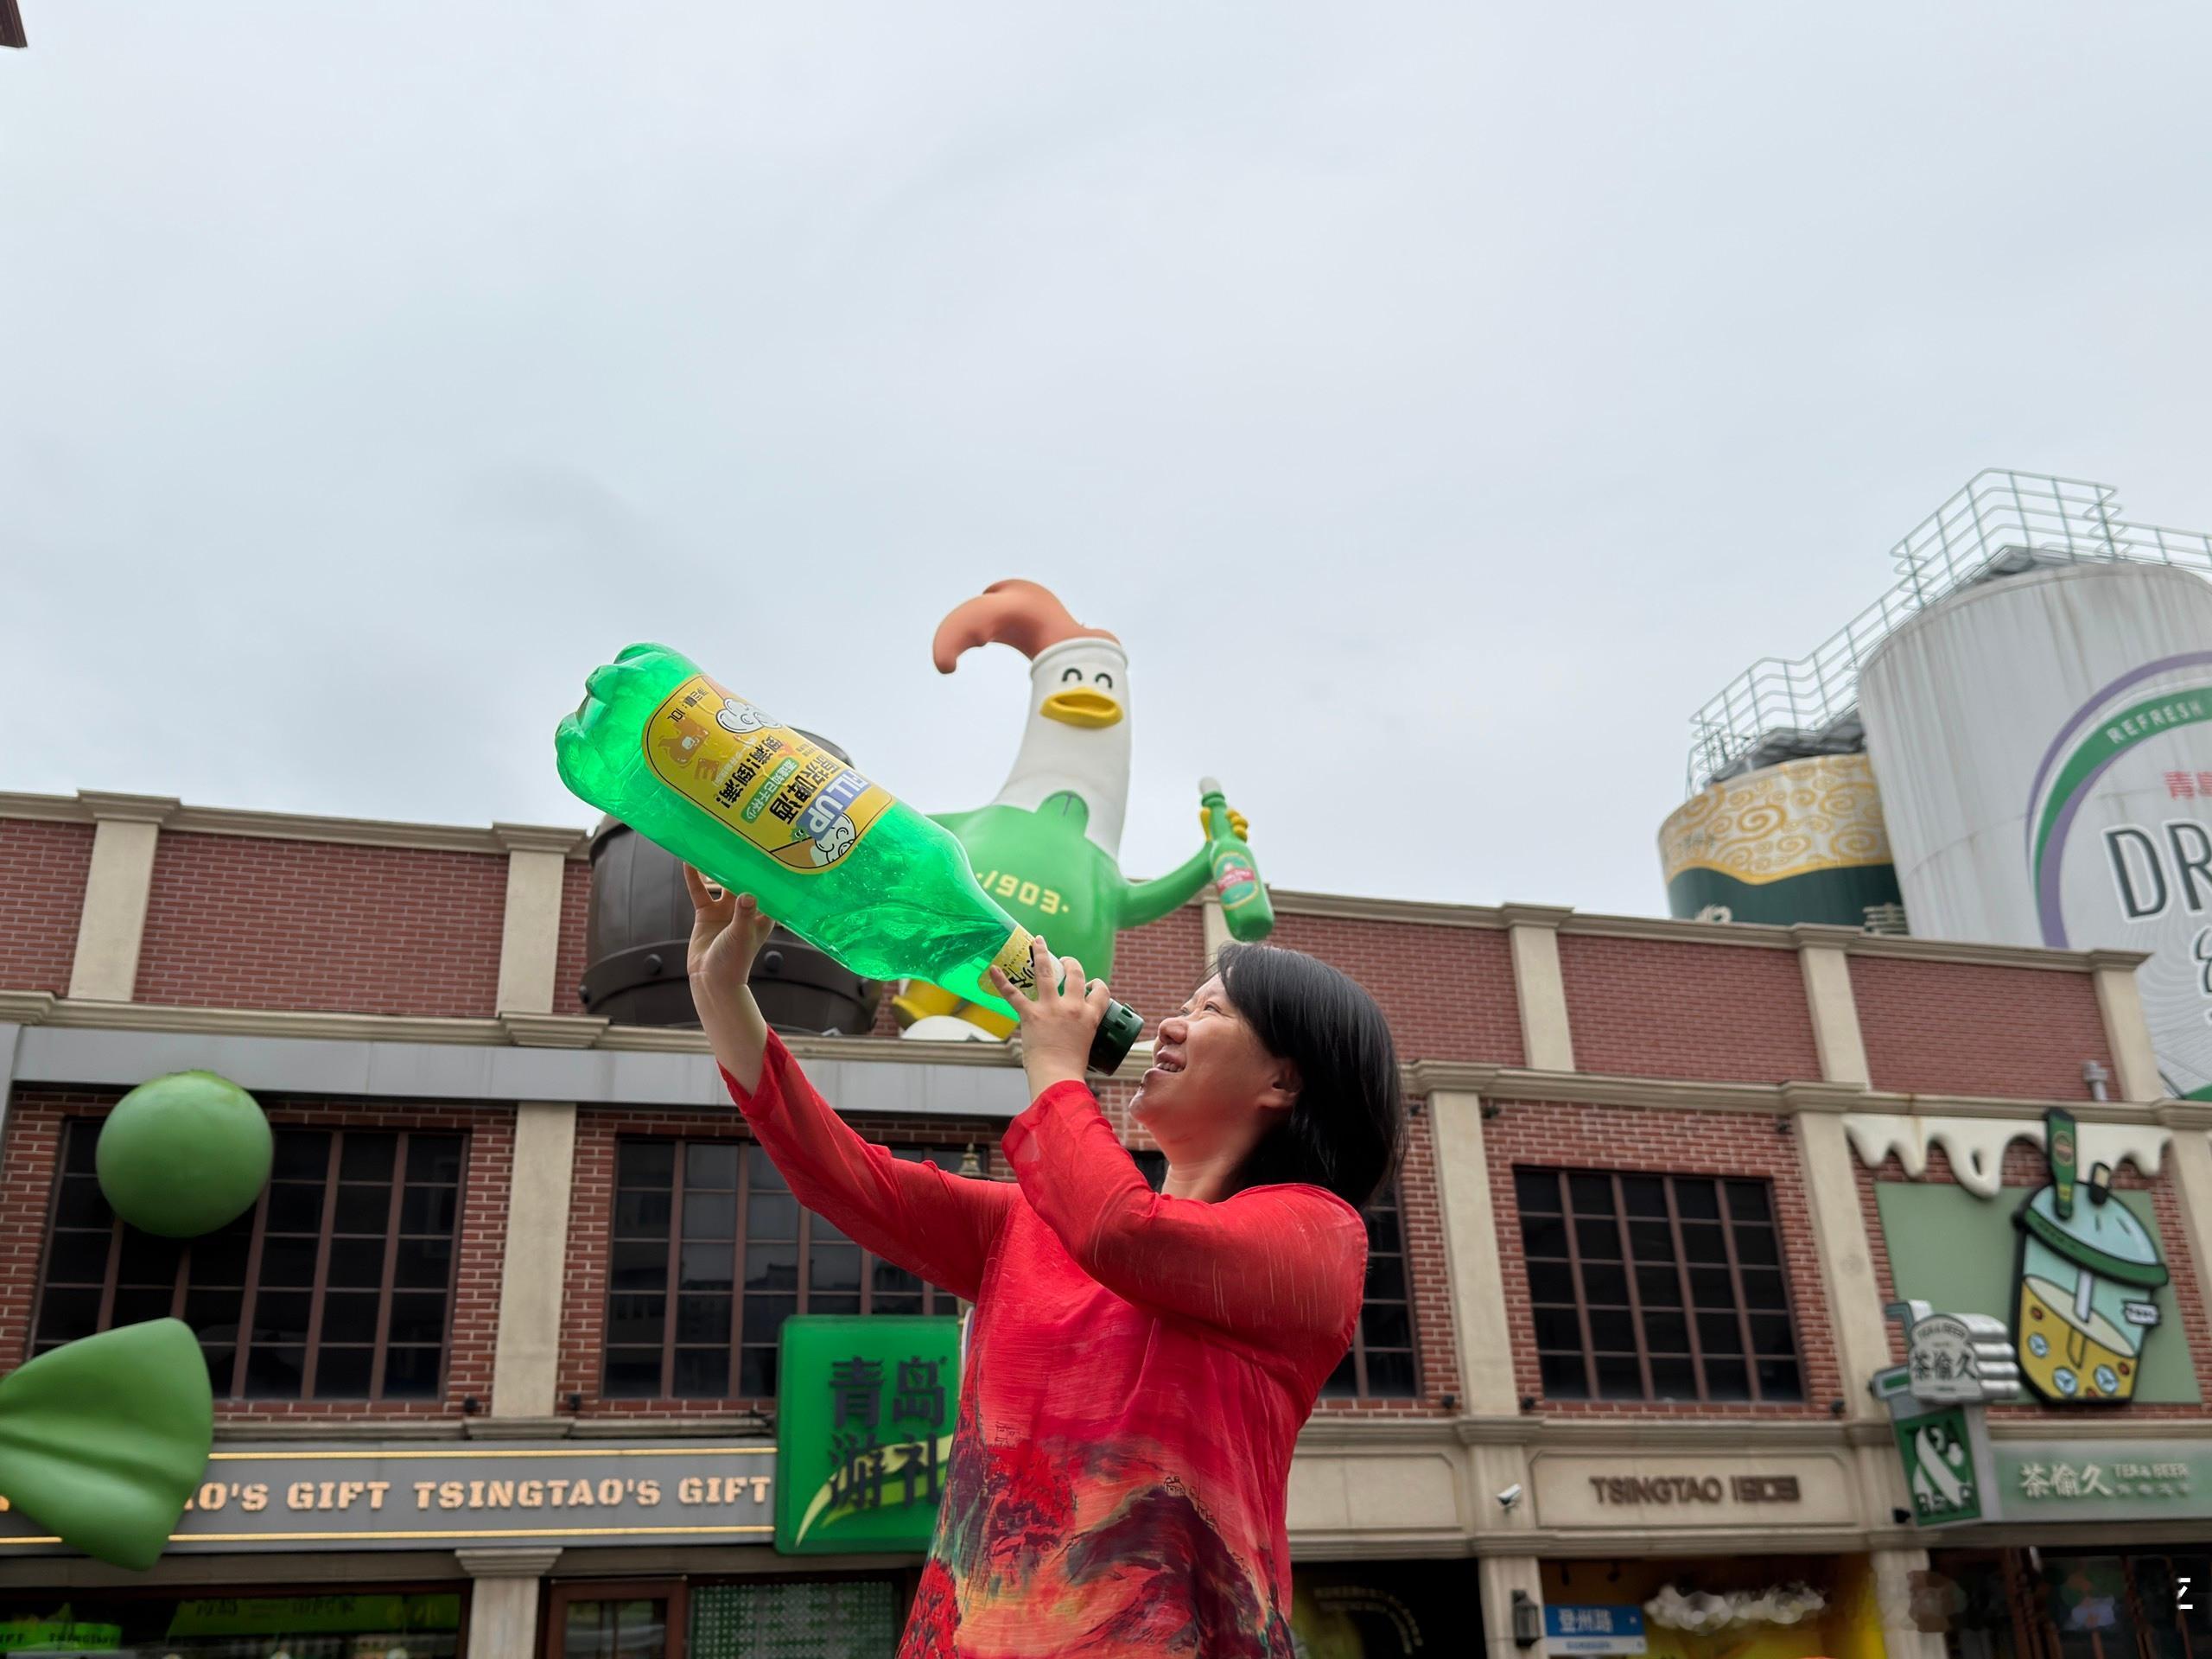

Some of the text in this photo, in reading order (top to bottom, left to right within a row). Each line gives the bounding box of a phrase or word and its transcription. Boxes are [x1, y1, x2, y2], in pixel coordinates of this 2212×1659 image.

[2107, 700, 2203, 744] REFRESH
[769, 753, 840, 824] 原浆啤酒
[825, 770, 869, 798] FILL
[807, 794, 843, 834] UP
[830, 1356, 945, 1427] 青岛
[288, 1481, 391, 1510] GIFT
[413, 1478, 662, 1510] TSINGTAO'S
[677, 1476, 771, 1504] GIFT
[1588, 1475, 1722, 1504] TSINGTAO
